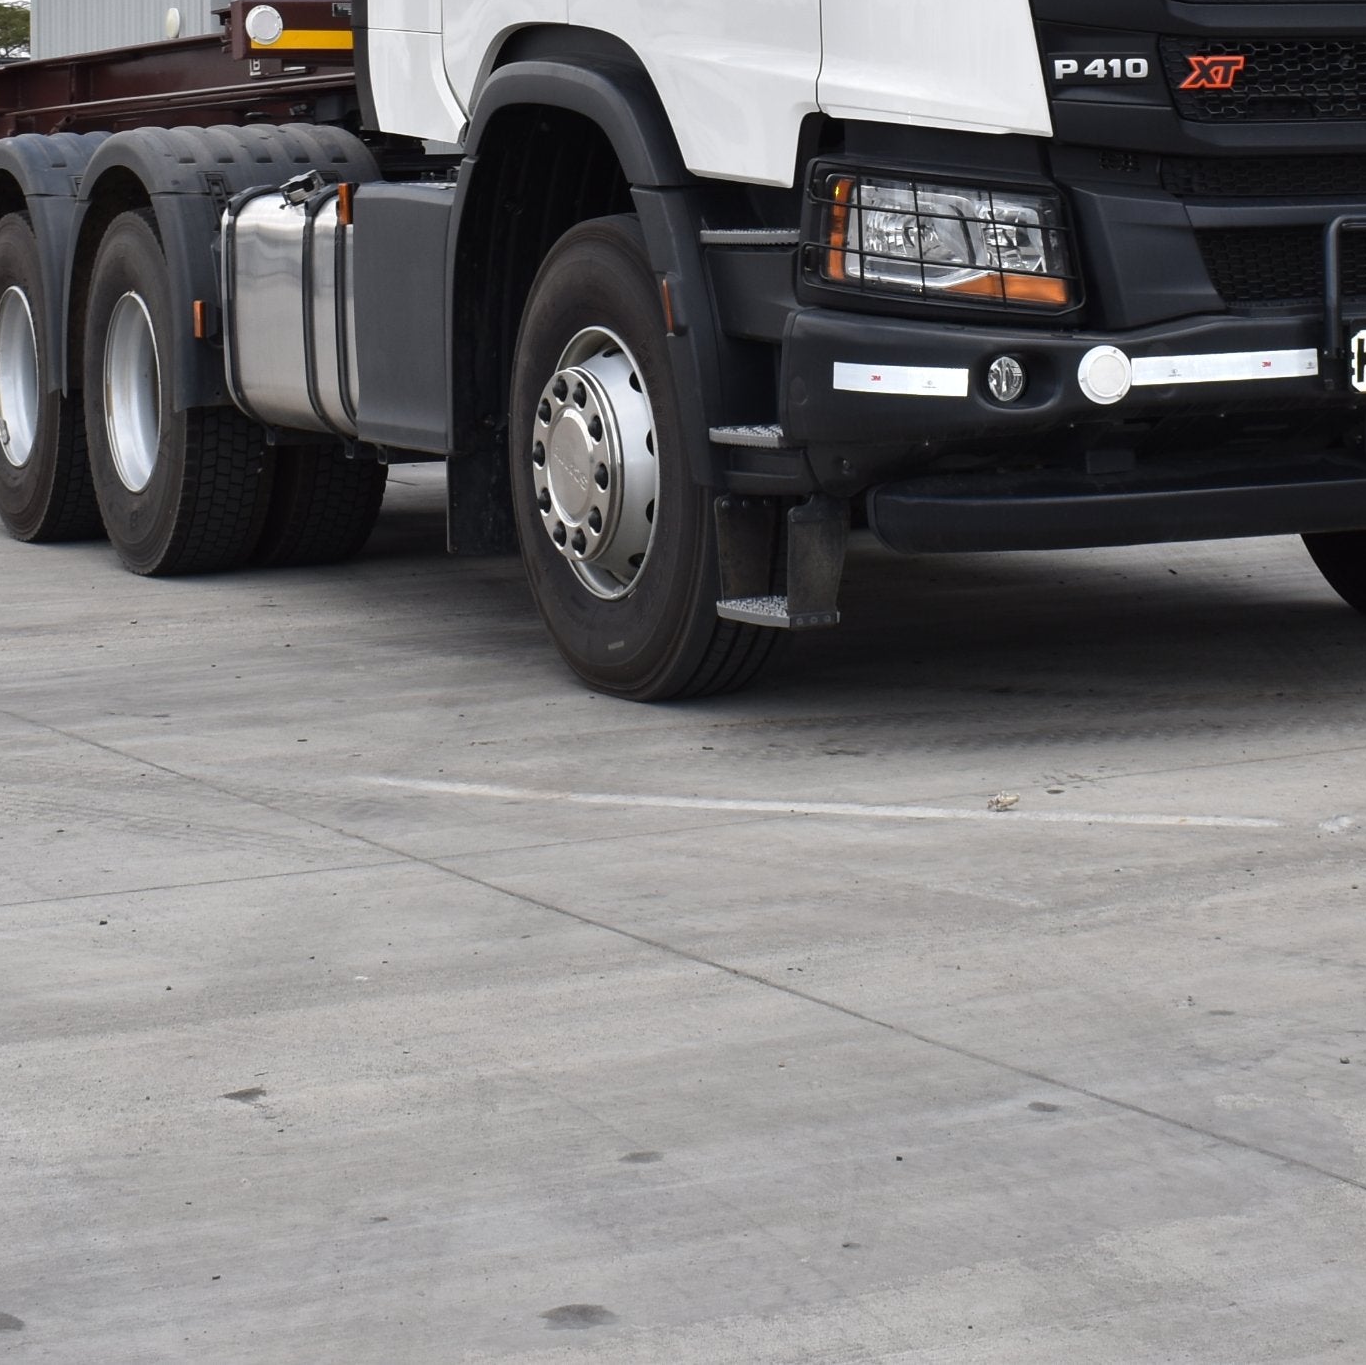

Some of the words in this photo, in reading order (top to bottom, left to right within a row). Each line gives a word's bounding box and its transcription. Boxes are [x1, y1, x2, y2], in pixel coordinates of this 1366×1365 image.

[1054, 60, 1079, 80] P
[1084, 58, 1148, 78] 410
[1180, 56, 1244, 89] XT
